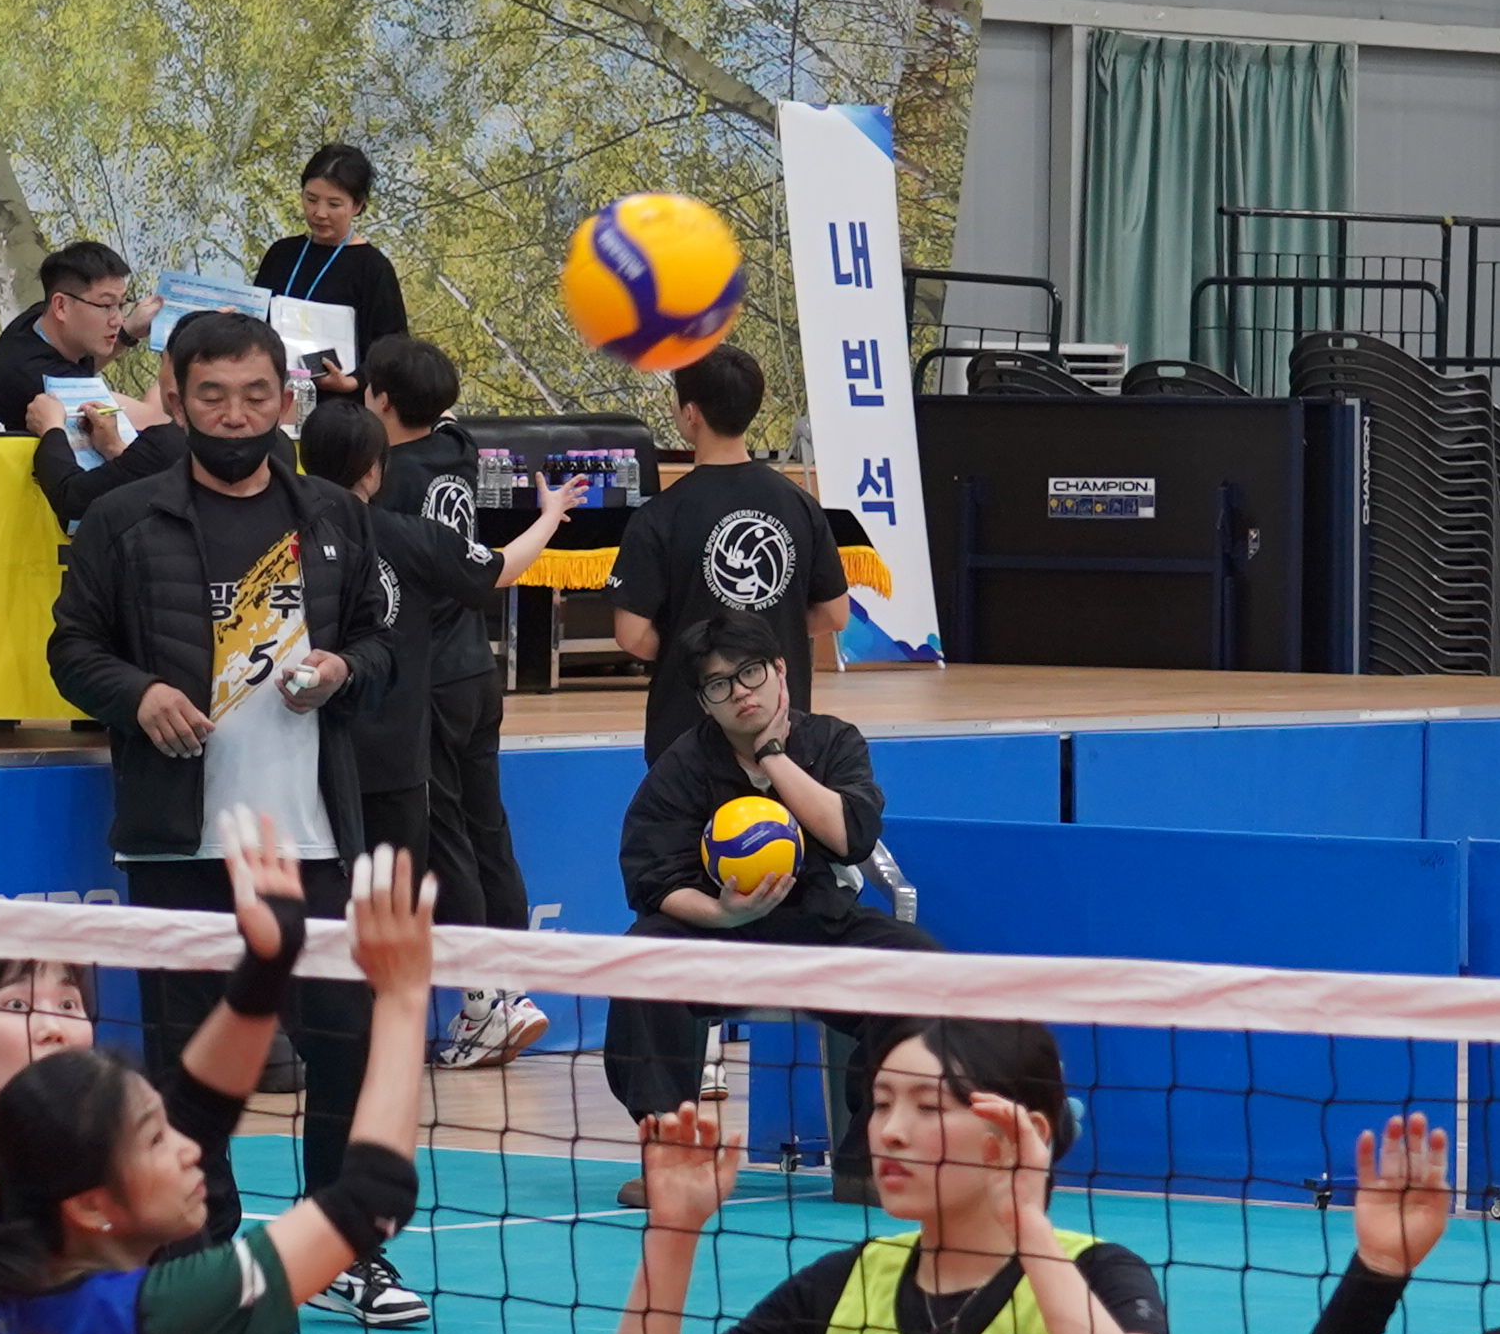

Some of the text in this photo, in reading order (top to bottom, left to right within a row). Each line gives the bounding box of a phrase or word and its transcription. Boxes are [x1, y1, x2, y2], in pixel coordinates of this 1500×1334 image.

[1053, 479, 1149, 493] CHAMPION
[1362, 416, 1371, 526] CHAMPION
[704, 525, 720, 554] SPORT
[718, 509, 766, 528] UNIVERSITY
[766, 514, 793, 545] SITTING
